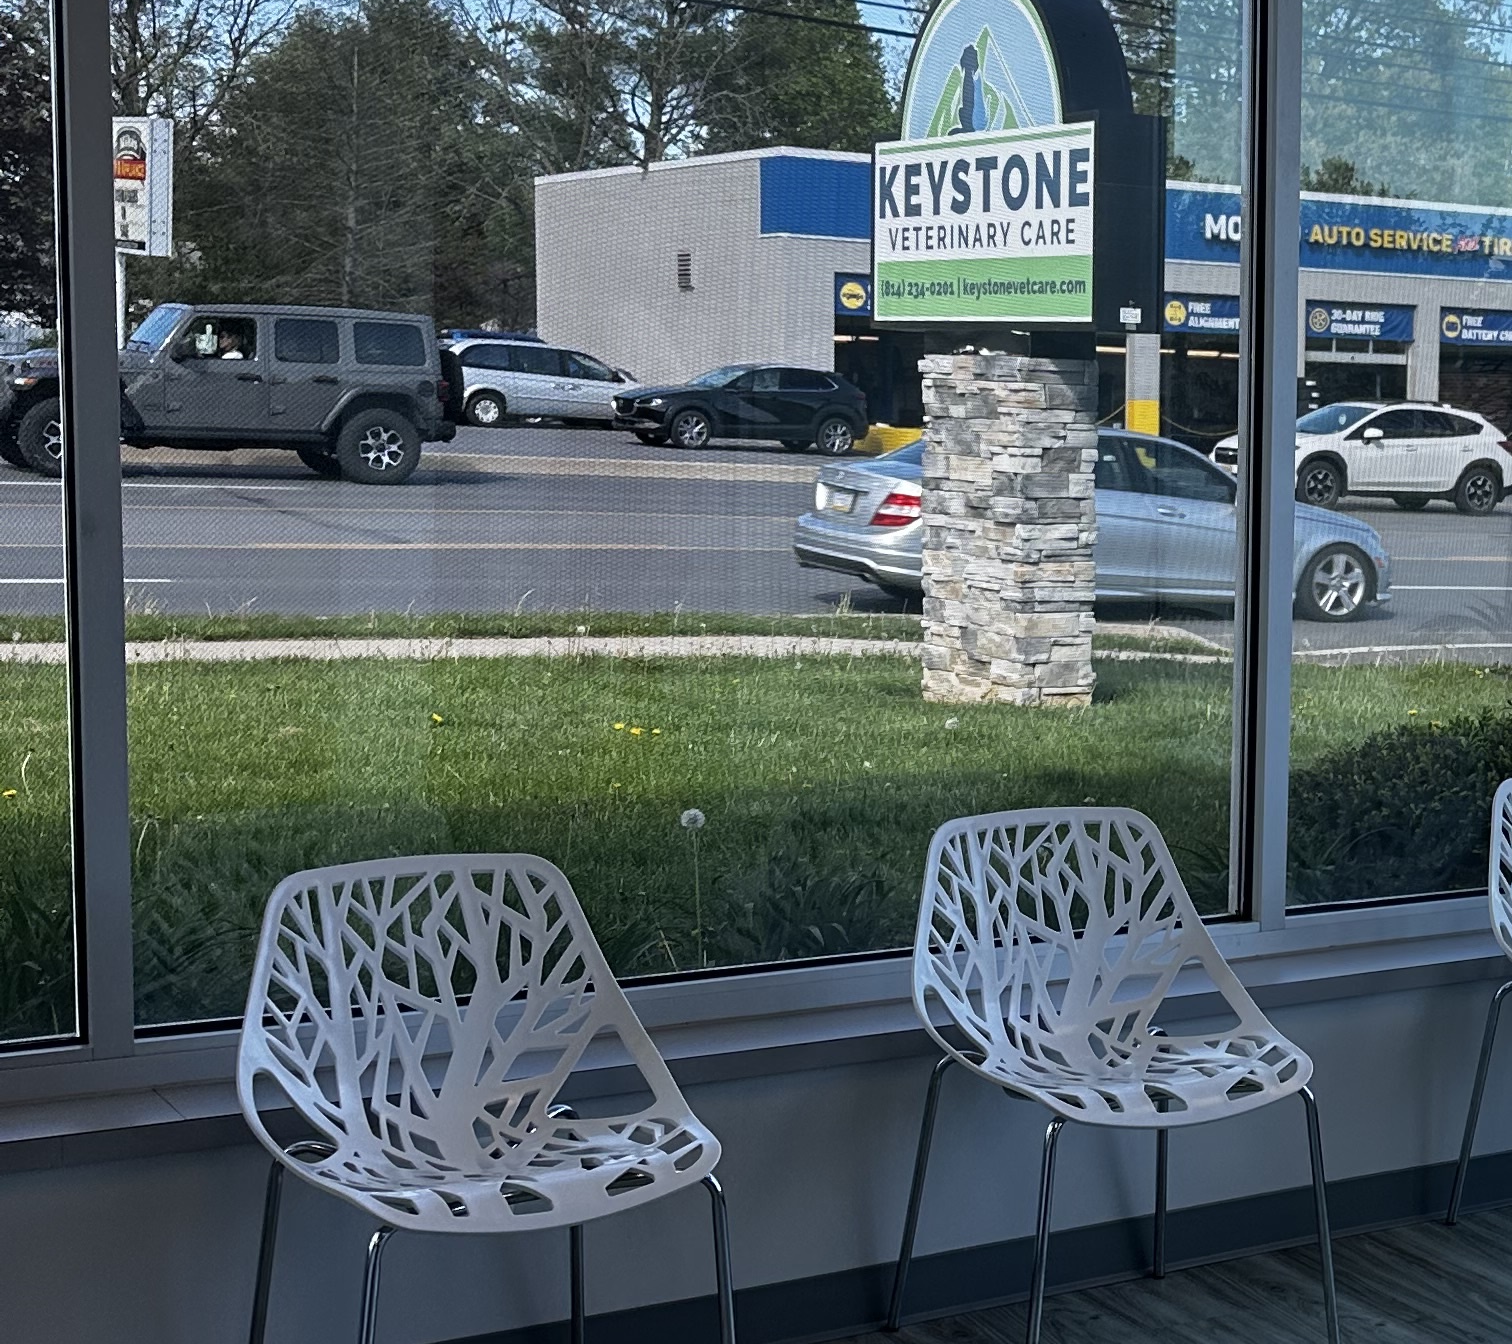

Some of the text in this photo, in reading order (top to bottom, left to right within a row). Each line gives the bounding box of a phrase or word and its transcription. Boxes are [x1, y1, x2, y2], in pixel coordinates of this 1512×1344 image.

[879, 148, 1090, 219] KEYSTONE
[889, 218, 1076, 251] VETERINARY CARE
[1309, 224, 1365, 247] AUTO
[1368, 228, 1454, 253] SERVICE
[880, 279, 906, 299] (814)
[907, 280, 955, 299] 234-0201
[962, 277, 1087, 301] keystonevetcare.com
[1188, 302, 1212, 314] FREE
[1462, 315, 1484, 327] FREE
